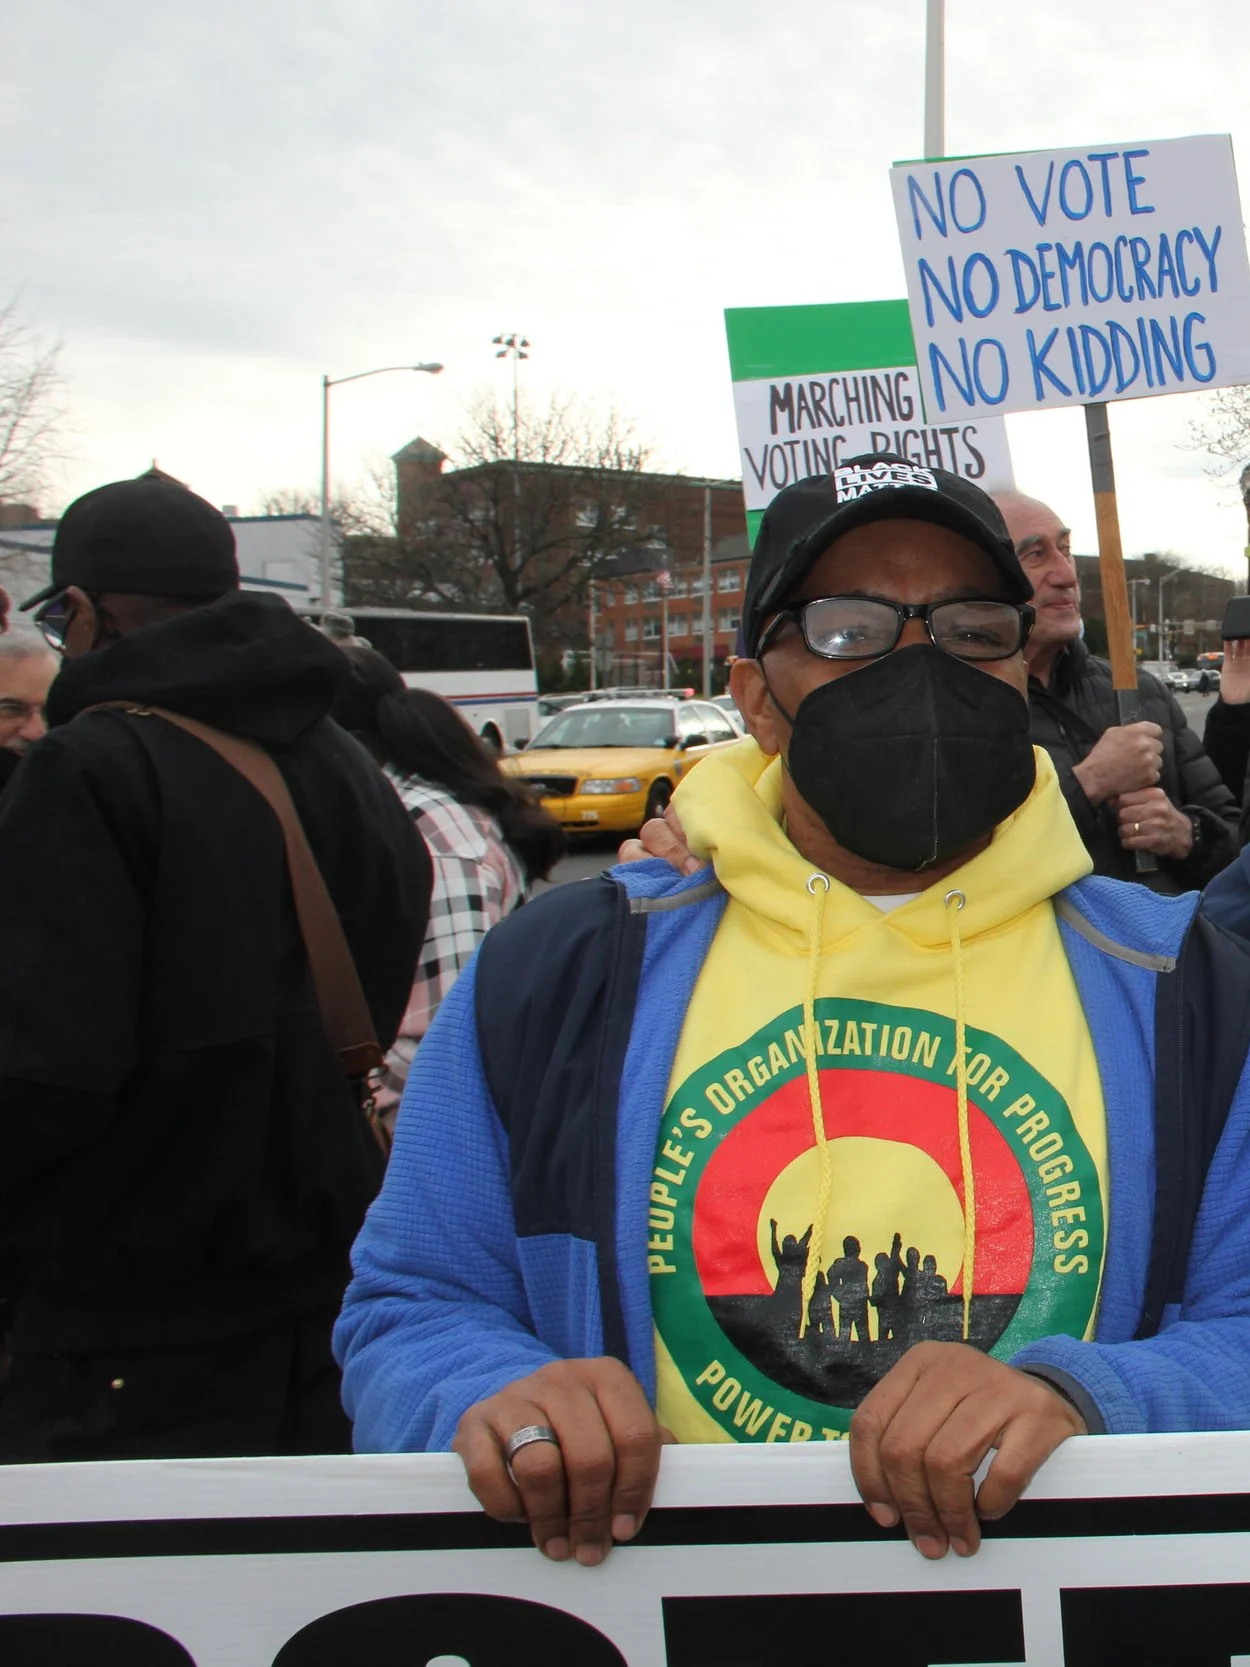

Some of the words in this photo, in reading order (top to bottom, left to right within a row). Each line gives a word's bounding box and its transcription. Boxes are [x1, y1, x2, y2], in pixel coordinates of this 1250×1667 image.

[907, 168, 987, 241] NO
[1015, 149, 1156, 227] VOTE
[918, 251, 1000, 329] NO
[1001, 225, 1222, 314] DEMOCRACY
[769, 371, 914, 436] MARCHING
[928, 337, 1010, 412] NO
[1026, 311, 1217, 401] KIDDING
[841, 470, 934, 487] LIVES
[649, 1106, 711, 1274] PEOPLE'S
[705, 1019, 942, 1116] ORGANIZATION
[1002, 1093, 1090, 1275] PROGRESS
